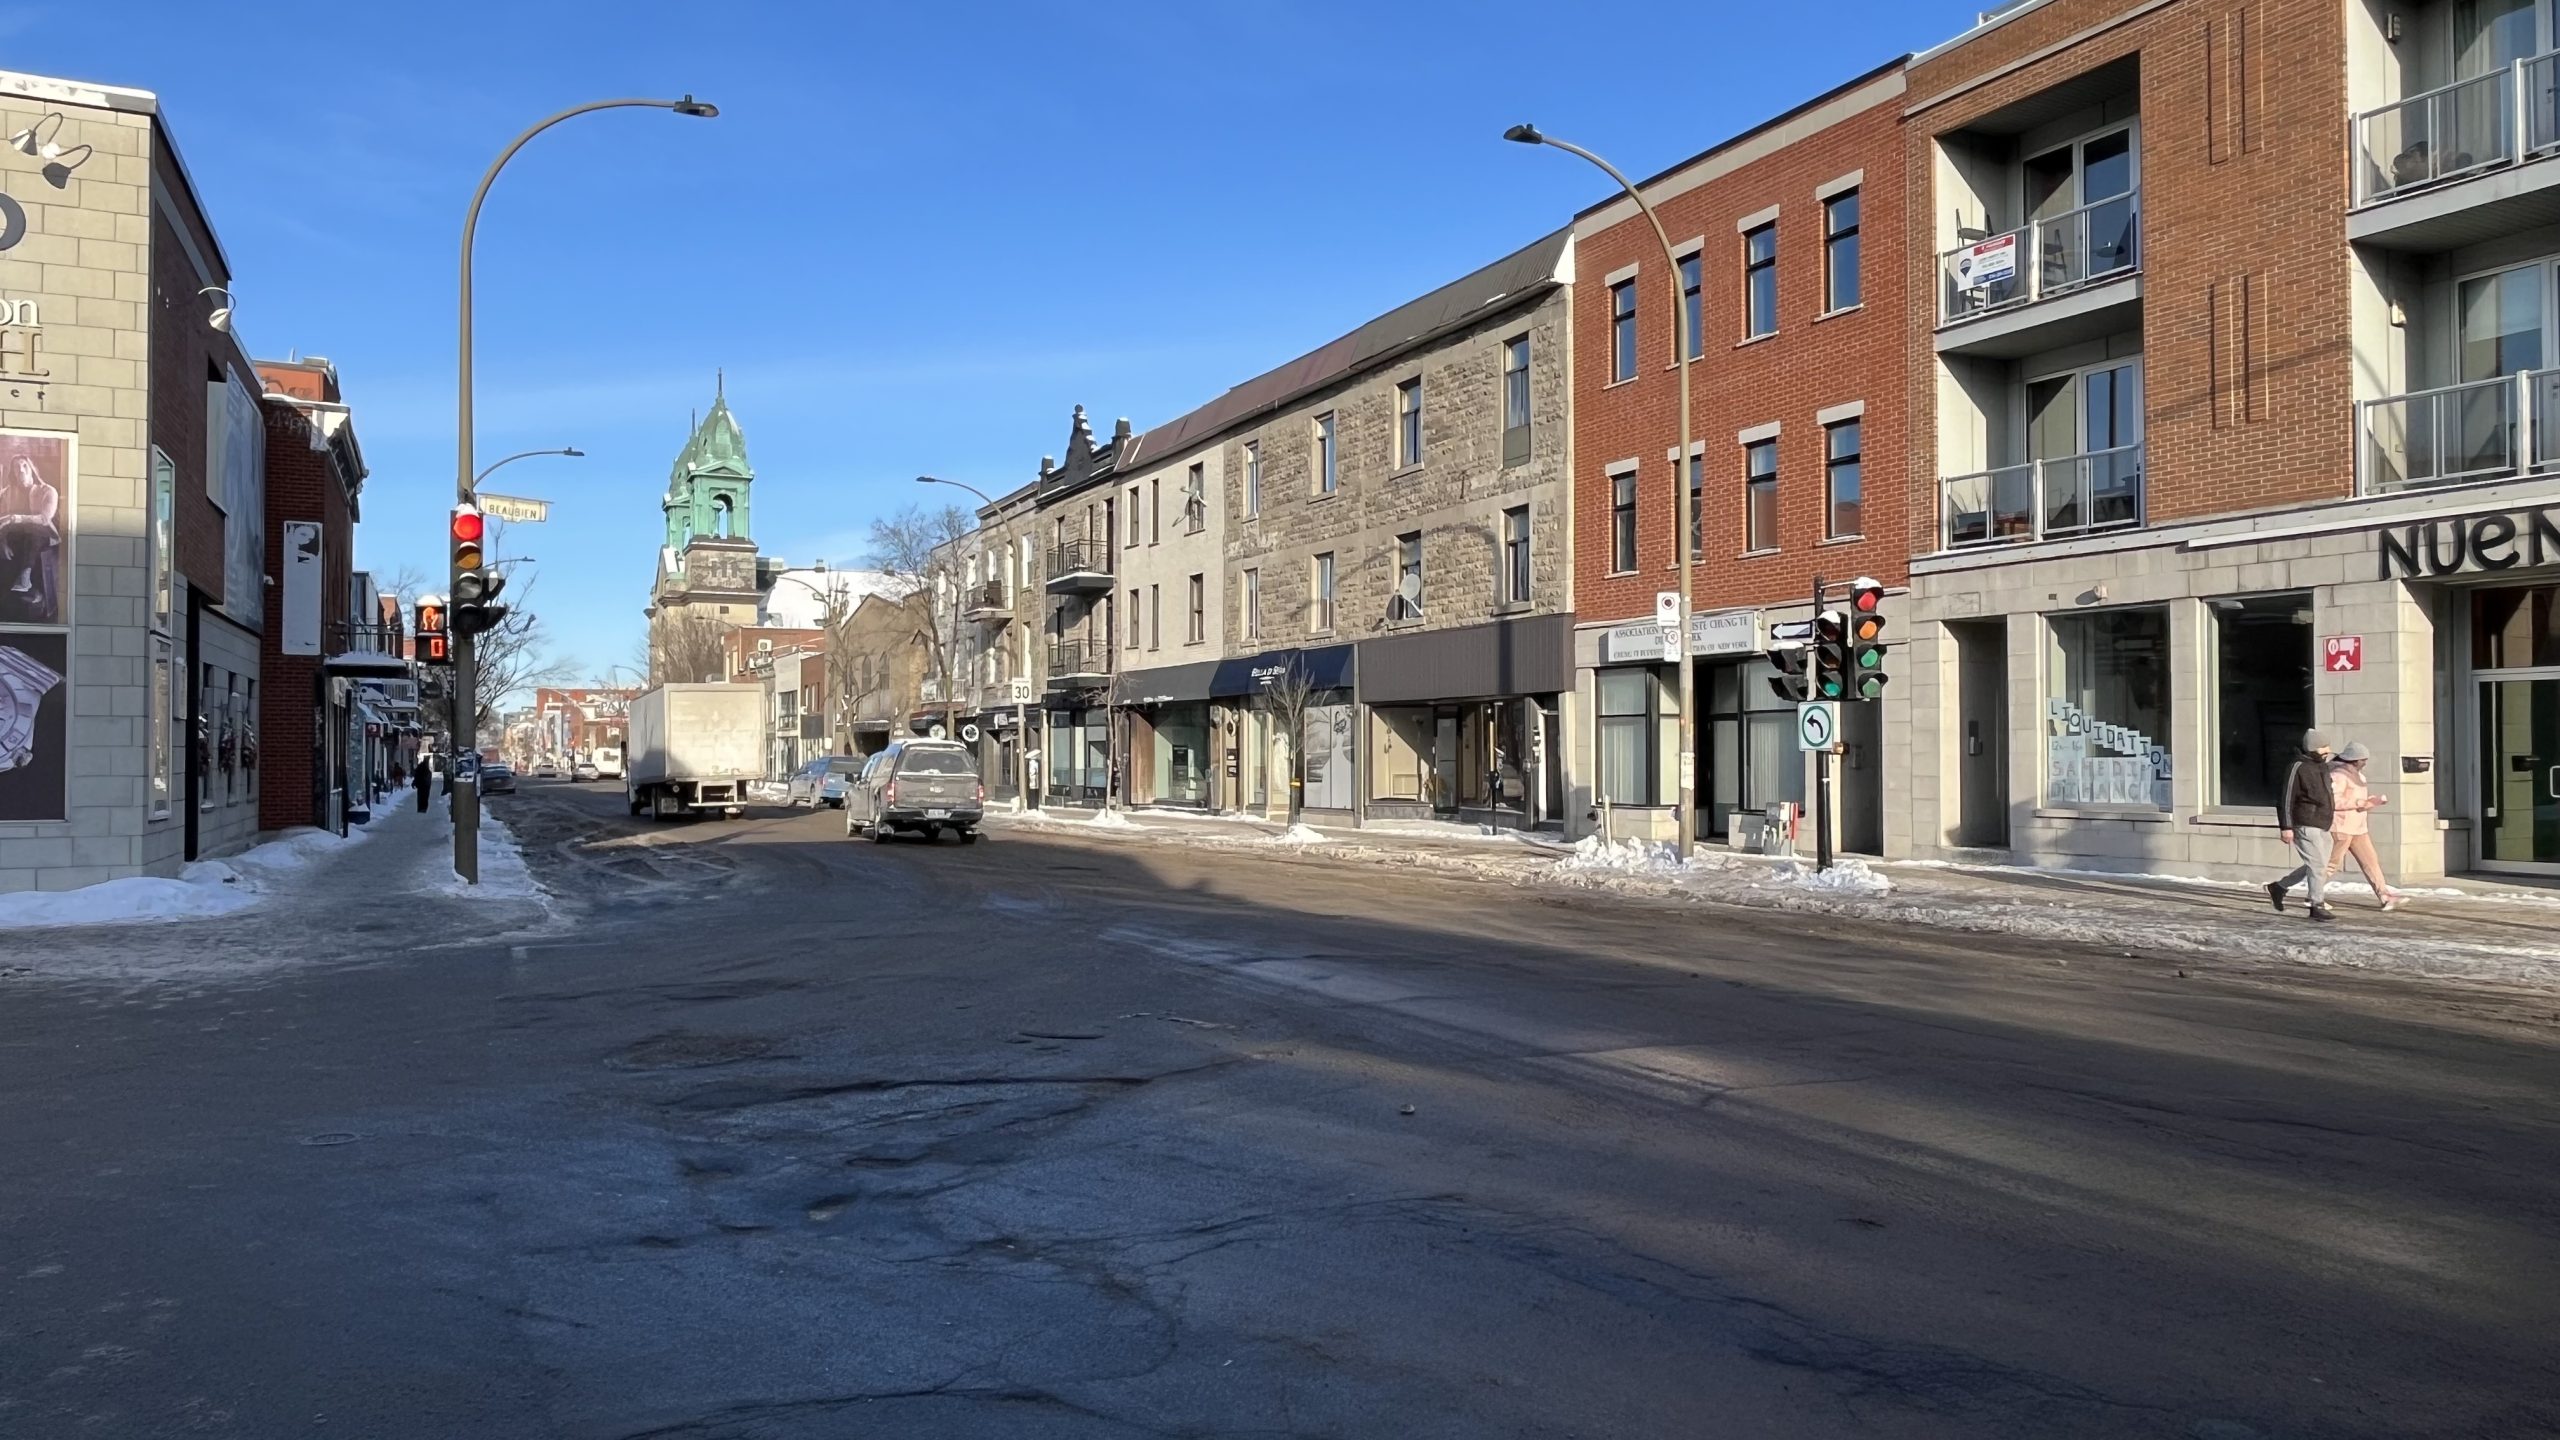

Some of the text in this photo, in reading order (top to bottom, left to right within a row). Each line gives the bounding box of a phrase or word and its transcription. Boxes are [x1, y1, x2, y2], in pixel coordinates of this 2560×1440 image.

[488, 504, 537, 519] BEAUBIEN
[1614, 626, 1658, 639] ASSOCIATION
[1014, 685, 1030, 699] 30
